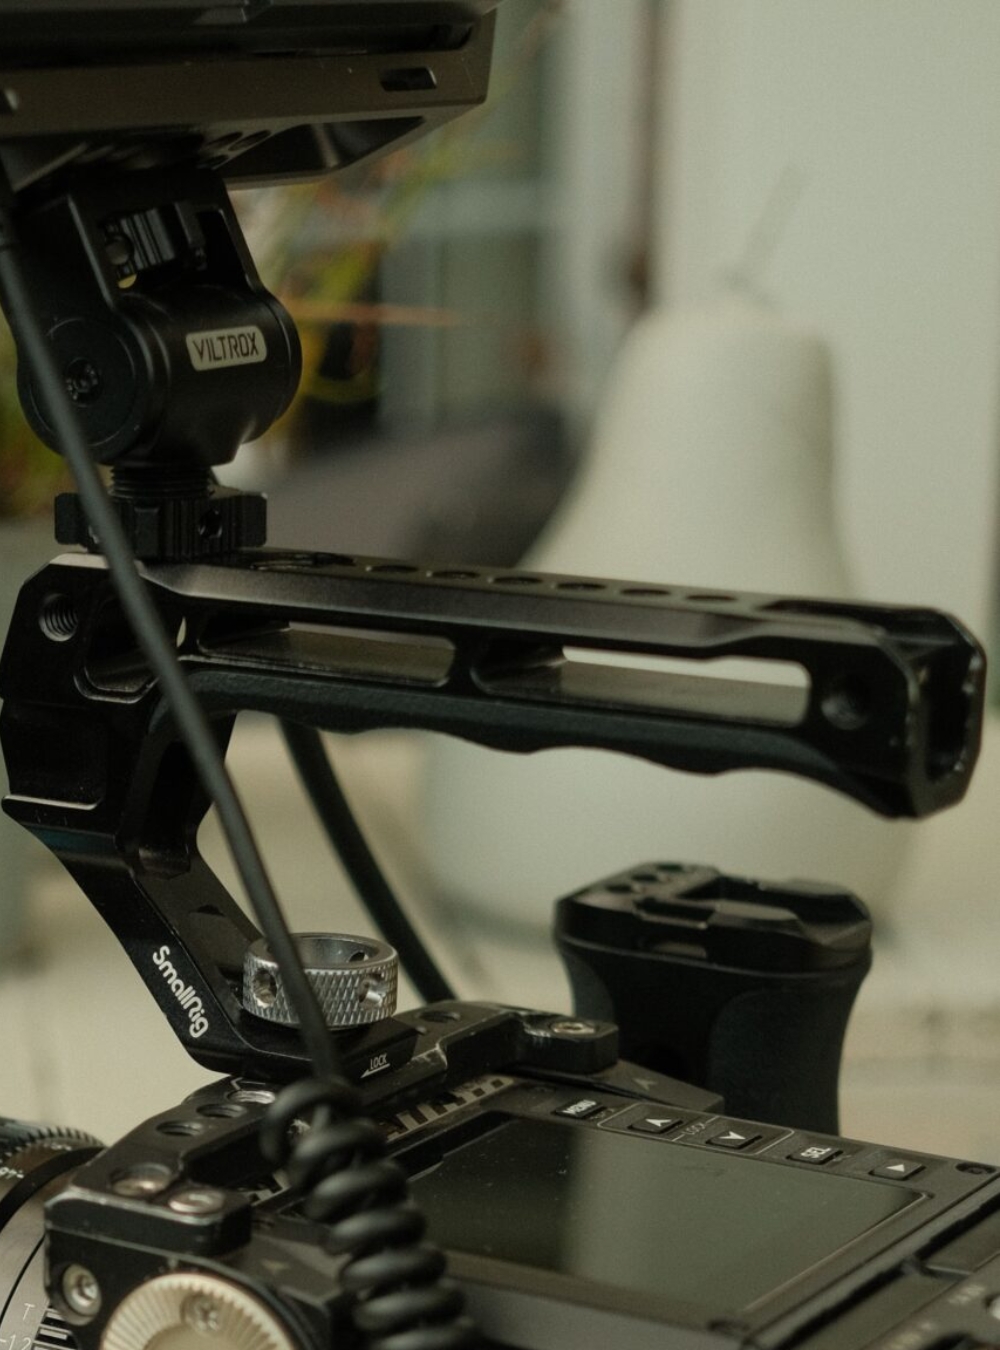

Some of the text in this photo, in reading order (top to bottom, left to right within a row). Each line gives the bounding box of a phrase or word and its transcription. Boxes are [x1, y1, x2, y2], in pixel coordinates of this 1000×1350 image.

[192, 332, 259, 362] VILTROX
[152, 945, 209, 1038] SmallRig
[369, 1053, 388, 1070] LOCK
[23, 1302, 36, 1321] T
